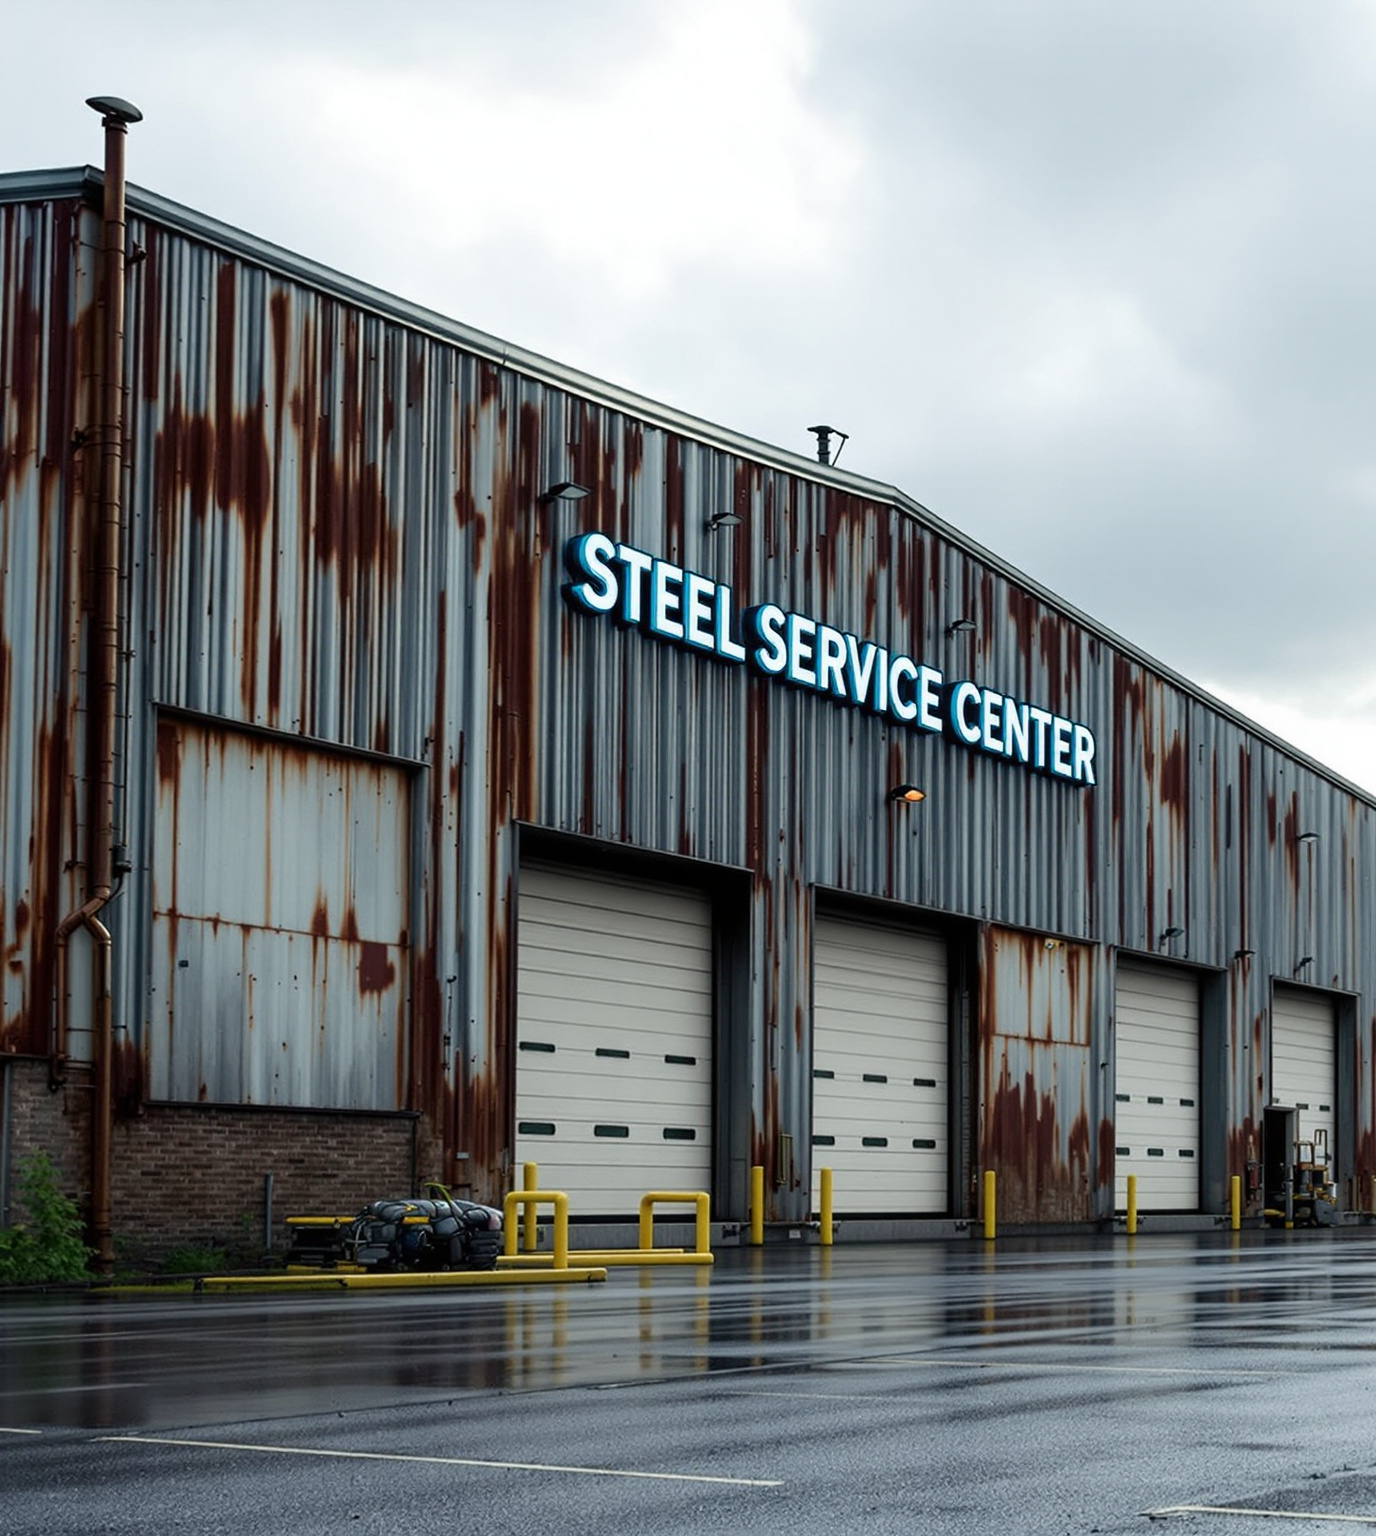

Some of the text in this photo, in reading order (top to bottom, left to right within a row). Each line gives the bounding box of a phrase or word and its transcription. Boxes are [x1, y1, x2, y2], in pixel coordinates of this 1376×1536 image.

[572, 532, 1097, 786] STEEL SERVICE CENTER
